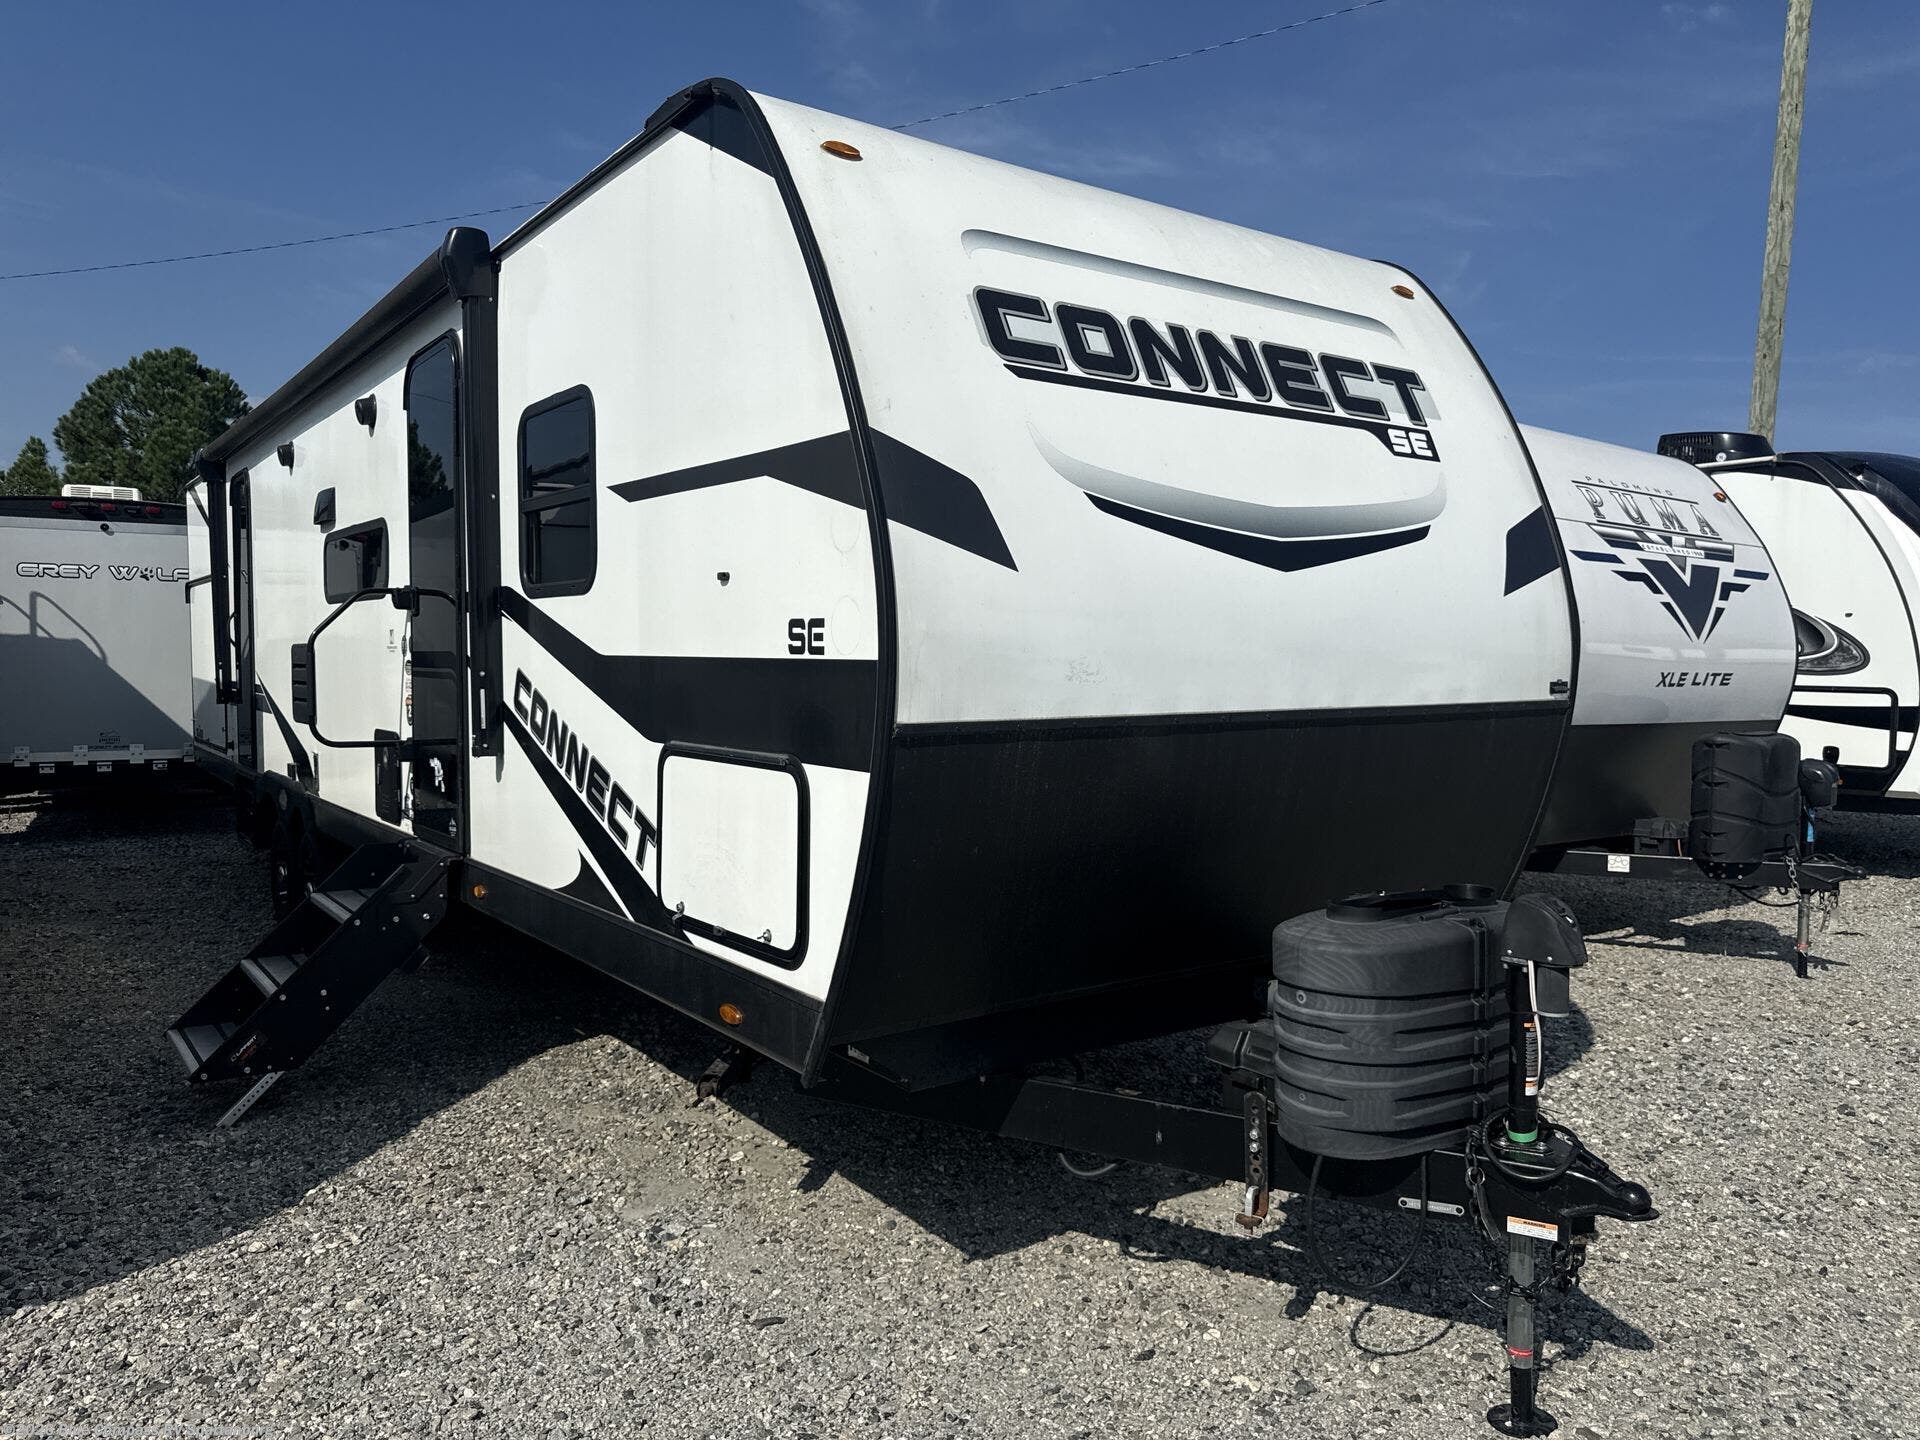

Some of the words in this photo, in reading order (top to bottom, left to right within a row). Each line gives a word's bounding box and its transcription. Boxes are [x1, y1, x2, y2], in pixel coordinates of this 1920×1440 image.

[971, 285, 1430, 427] CONNECT
[1387, 427, 1434, 459] SE
[1584, 475, 1675, 497] PALOMINO
[1575, 485, 1720, 537] PUMA
[16, 561, 100, 580] GREY
[787, 617, 826, 656] SE
[1655, 671, 1689, 688] XLE
[1690, 671, 1734, 687] LITE
[513, 667, 657, 871] CONNECT
